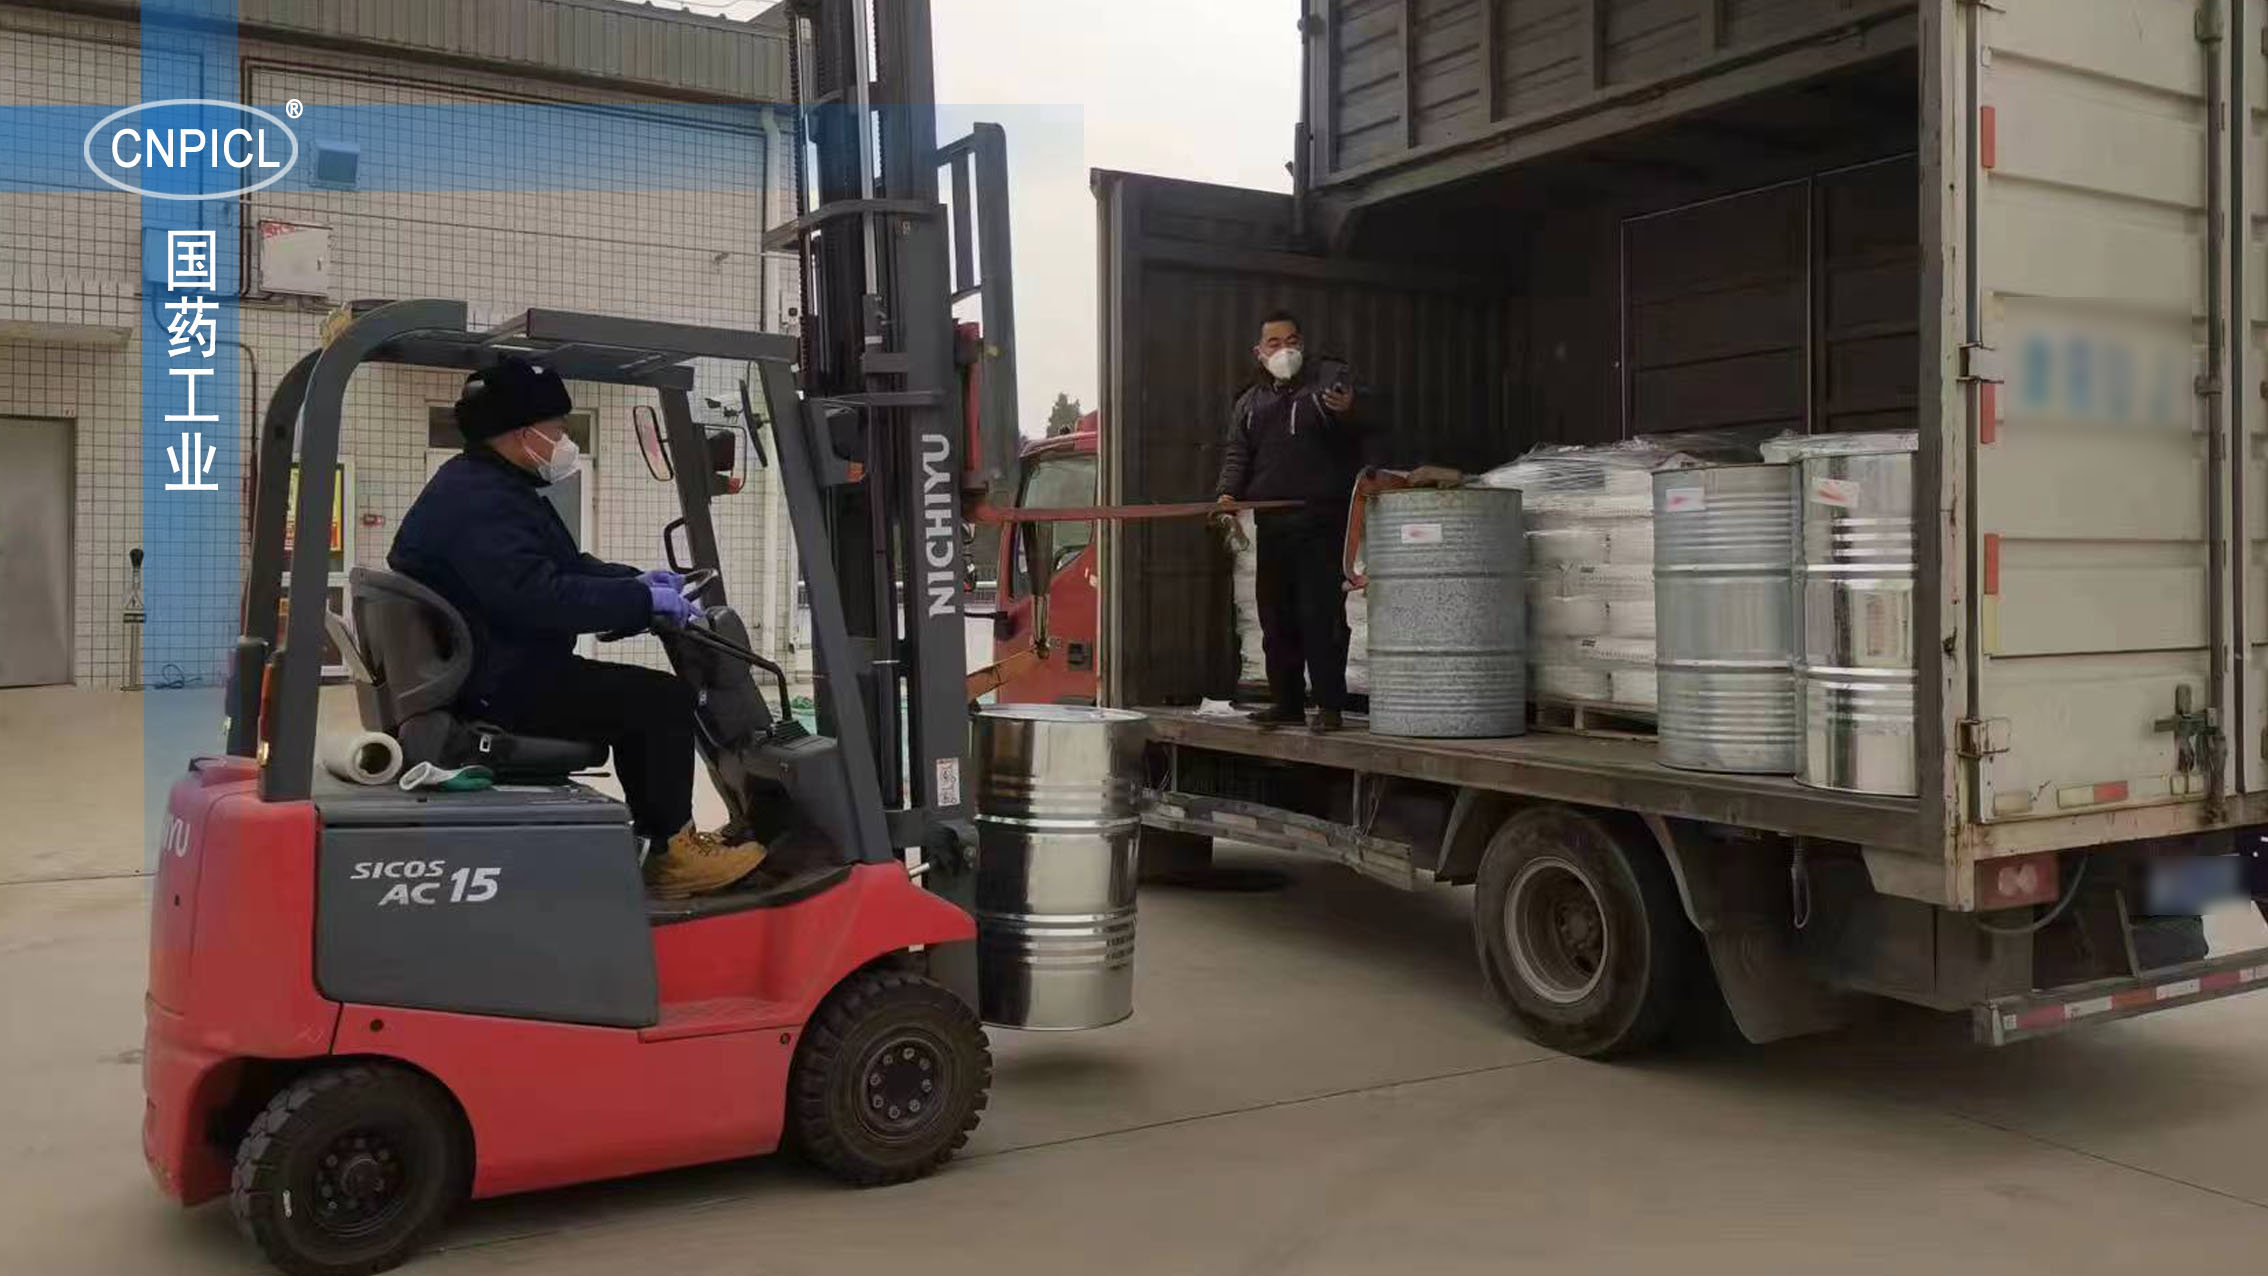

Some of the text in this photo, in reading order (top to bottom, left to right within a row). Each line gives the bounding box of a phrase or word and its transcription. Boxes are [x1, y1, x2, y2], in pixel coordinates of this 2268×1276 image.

[922, 434, 956, 617] NICHIYU
[350, 860, 446, 879] SICOS
[378, 867, 502, 906] AC 15
